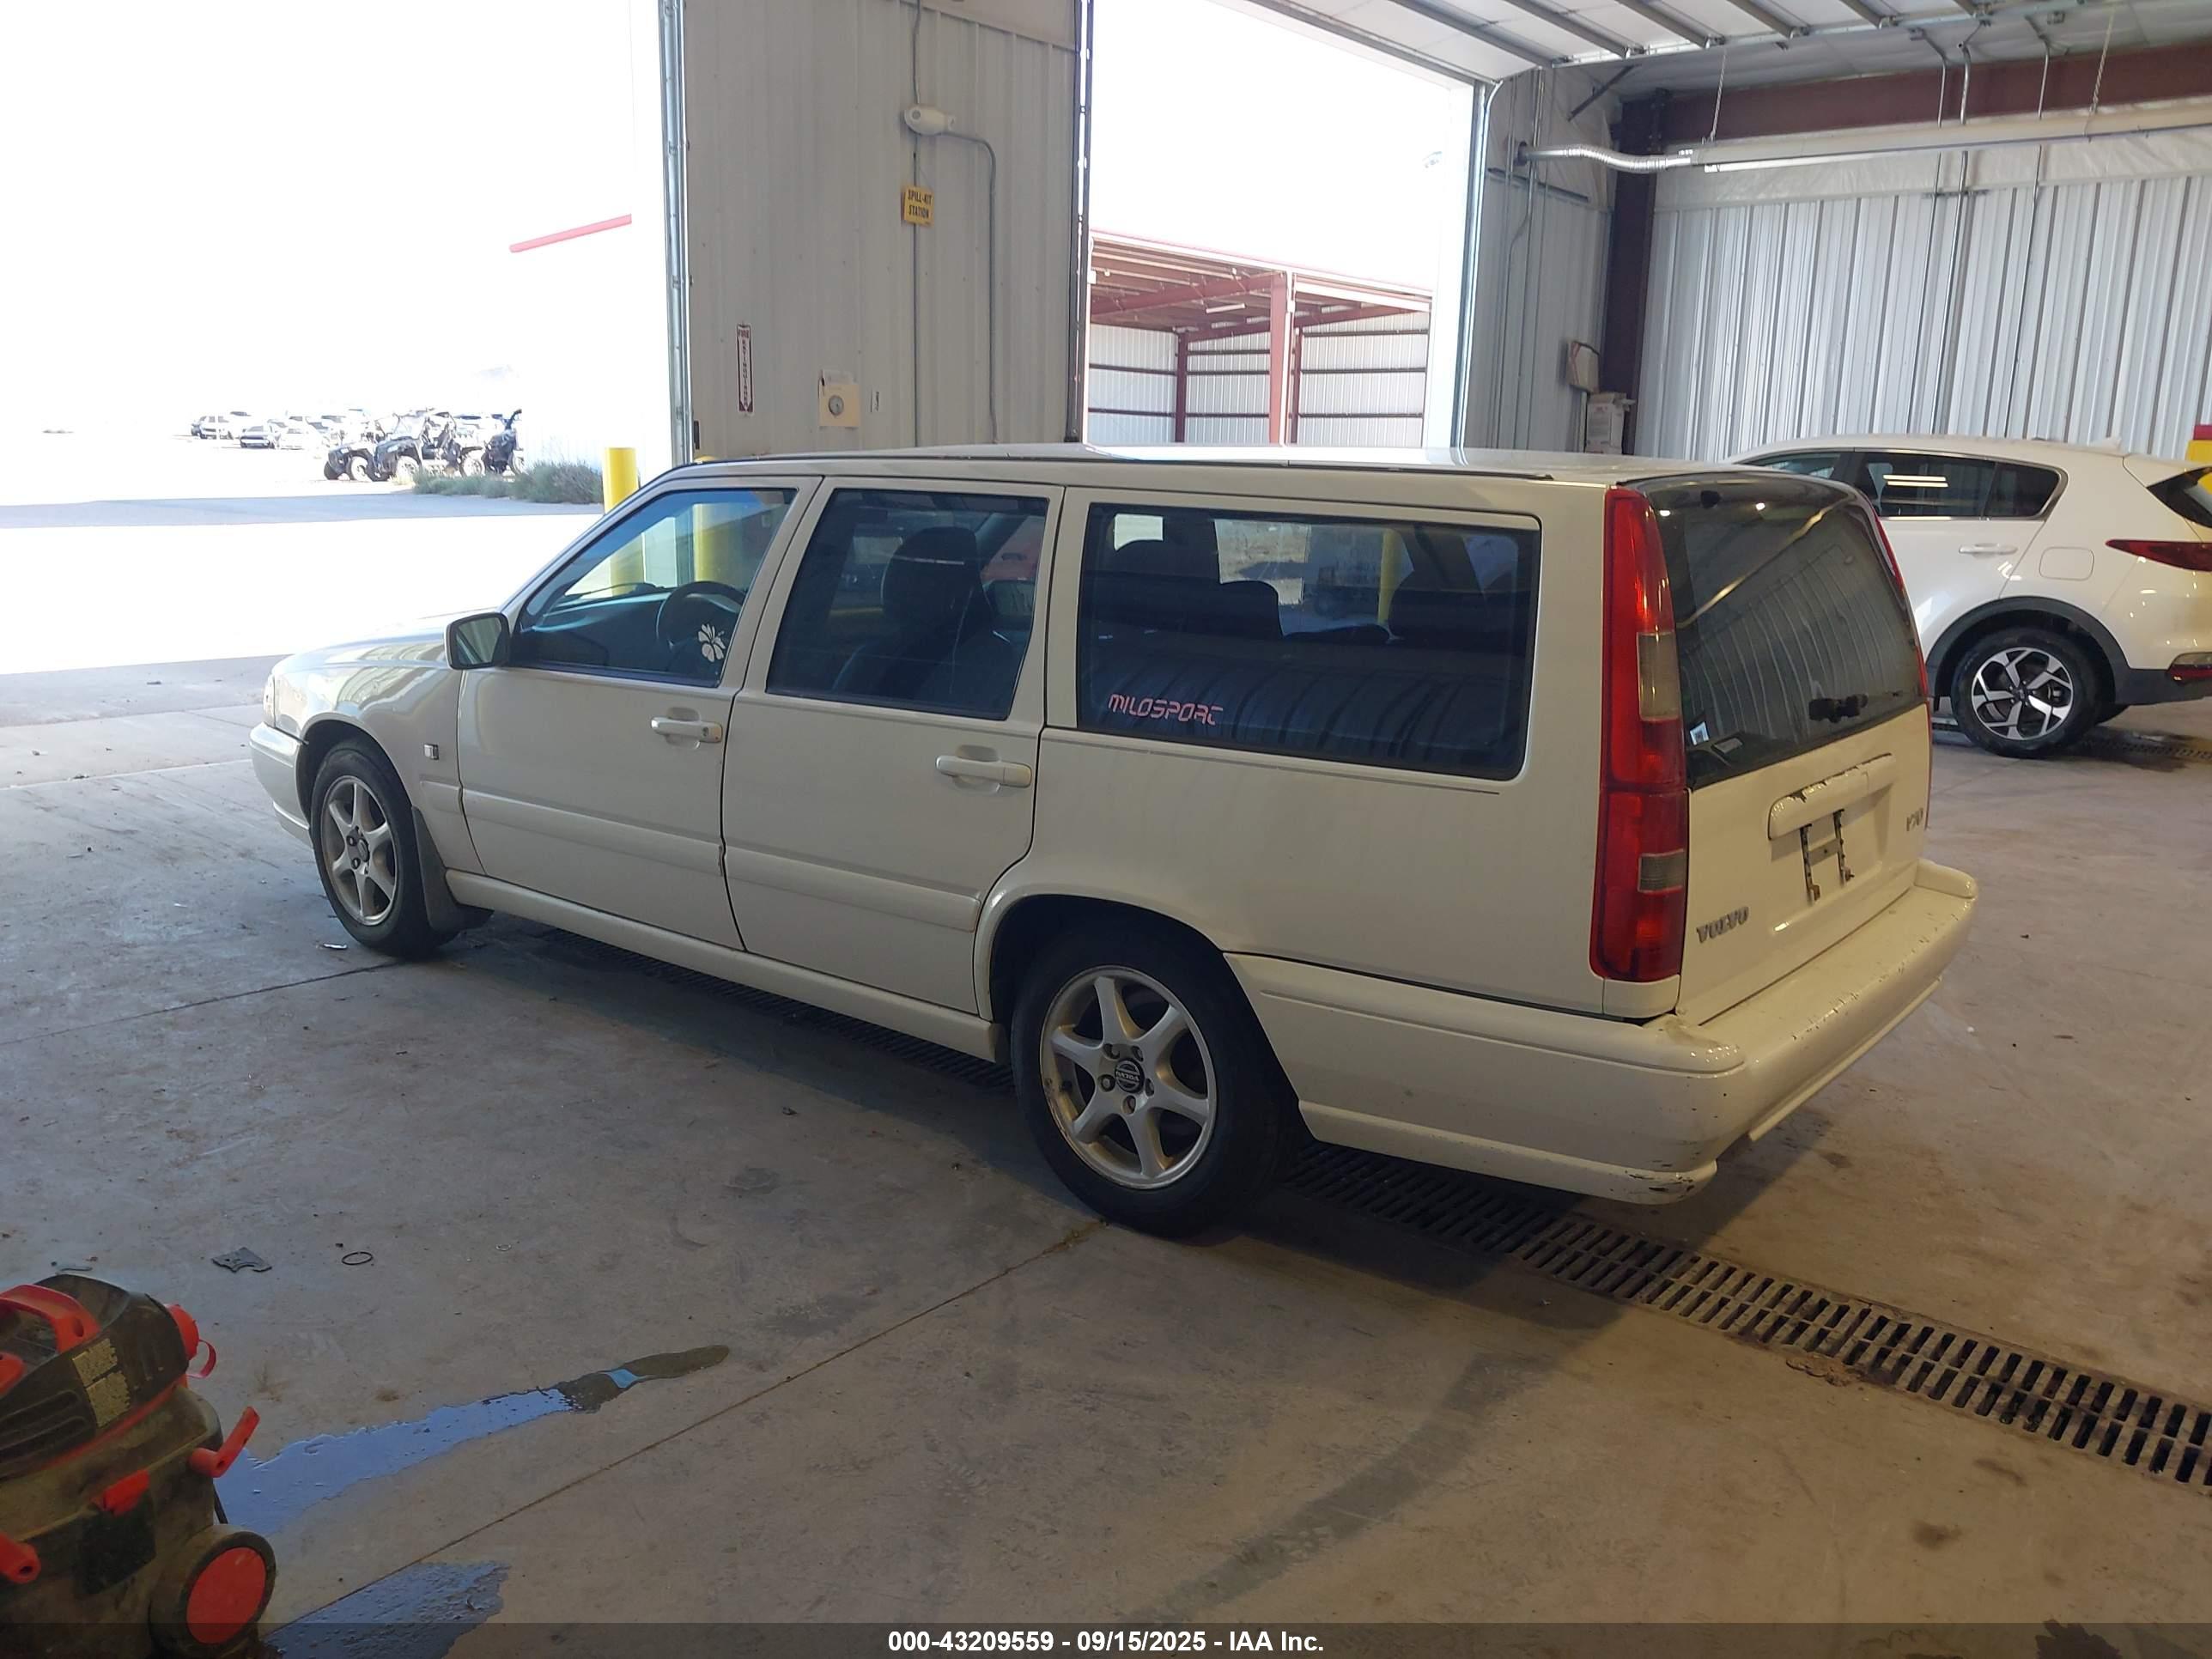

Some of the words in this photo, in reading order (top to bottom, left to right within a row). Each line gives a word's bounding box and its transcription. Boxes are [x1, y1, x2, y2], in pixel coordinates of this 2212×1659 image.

[908, 205, 929, 219] STATION
[1108, 694, 1224, 726] MILOSPORT
[1696, 906, 1749, 944] VOLVO
